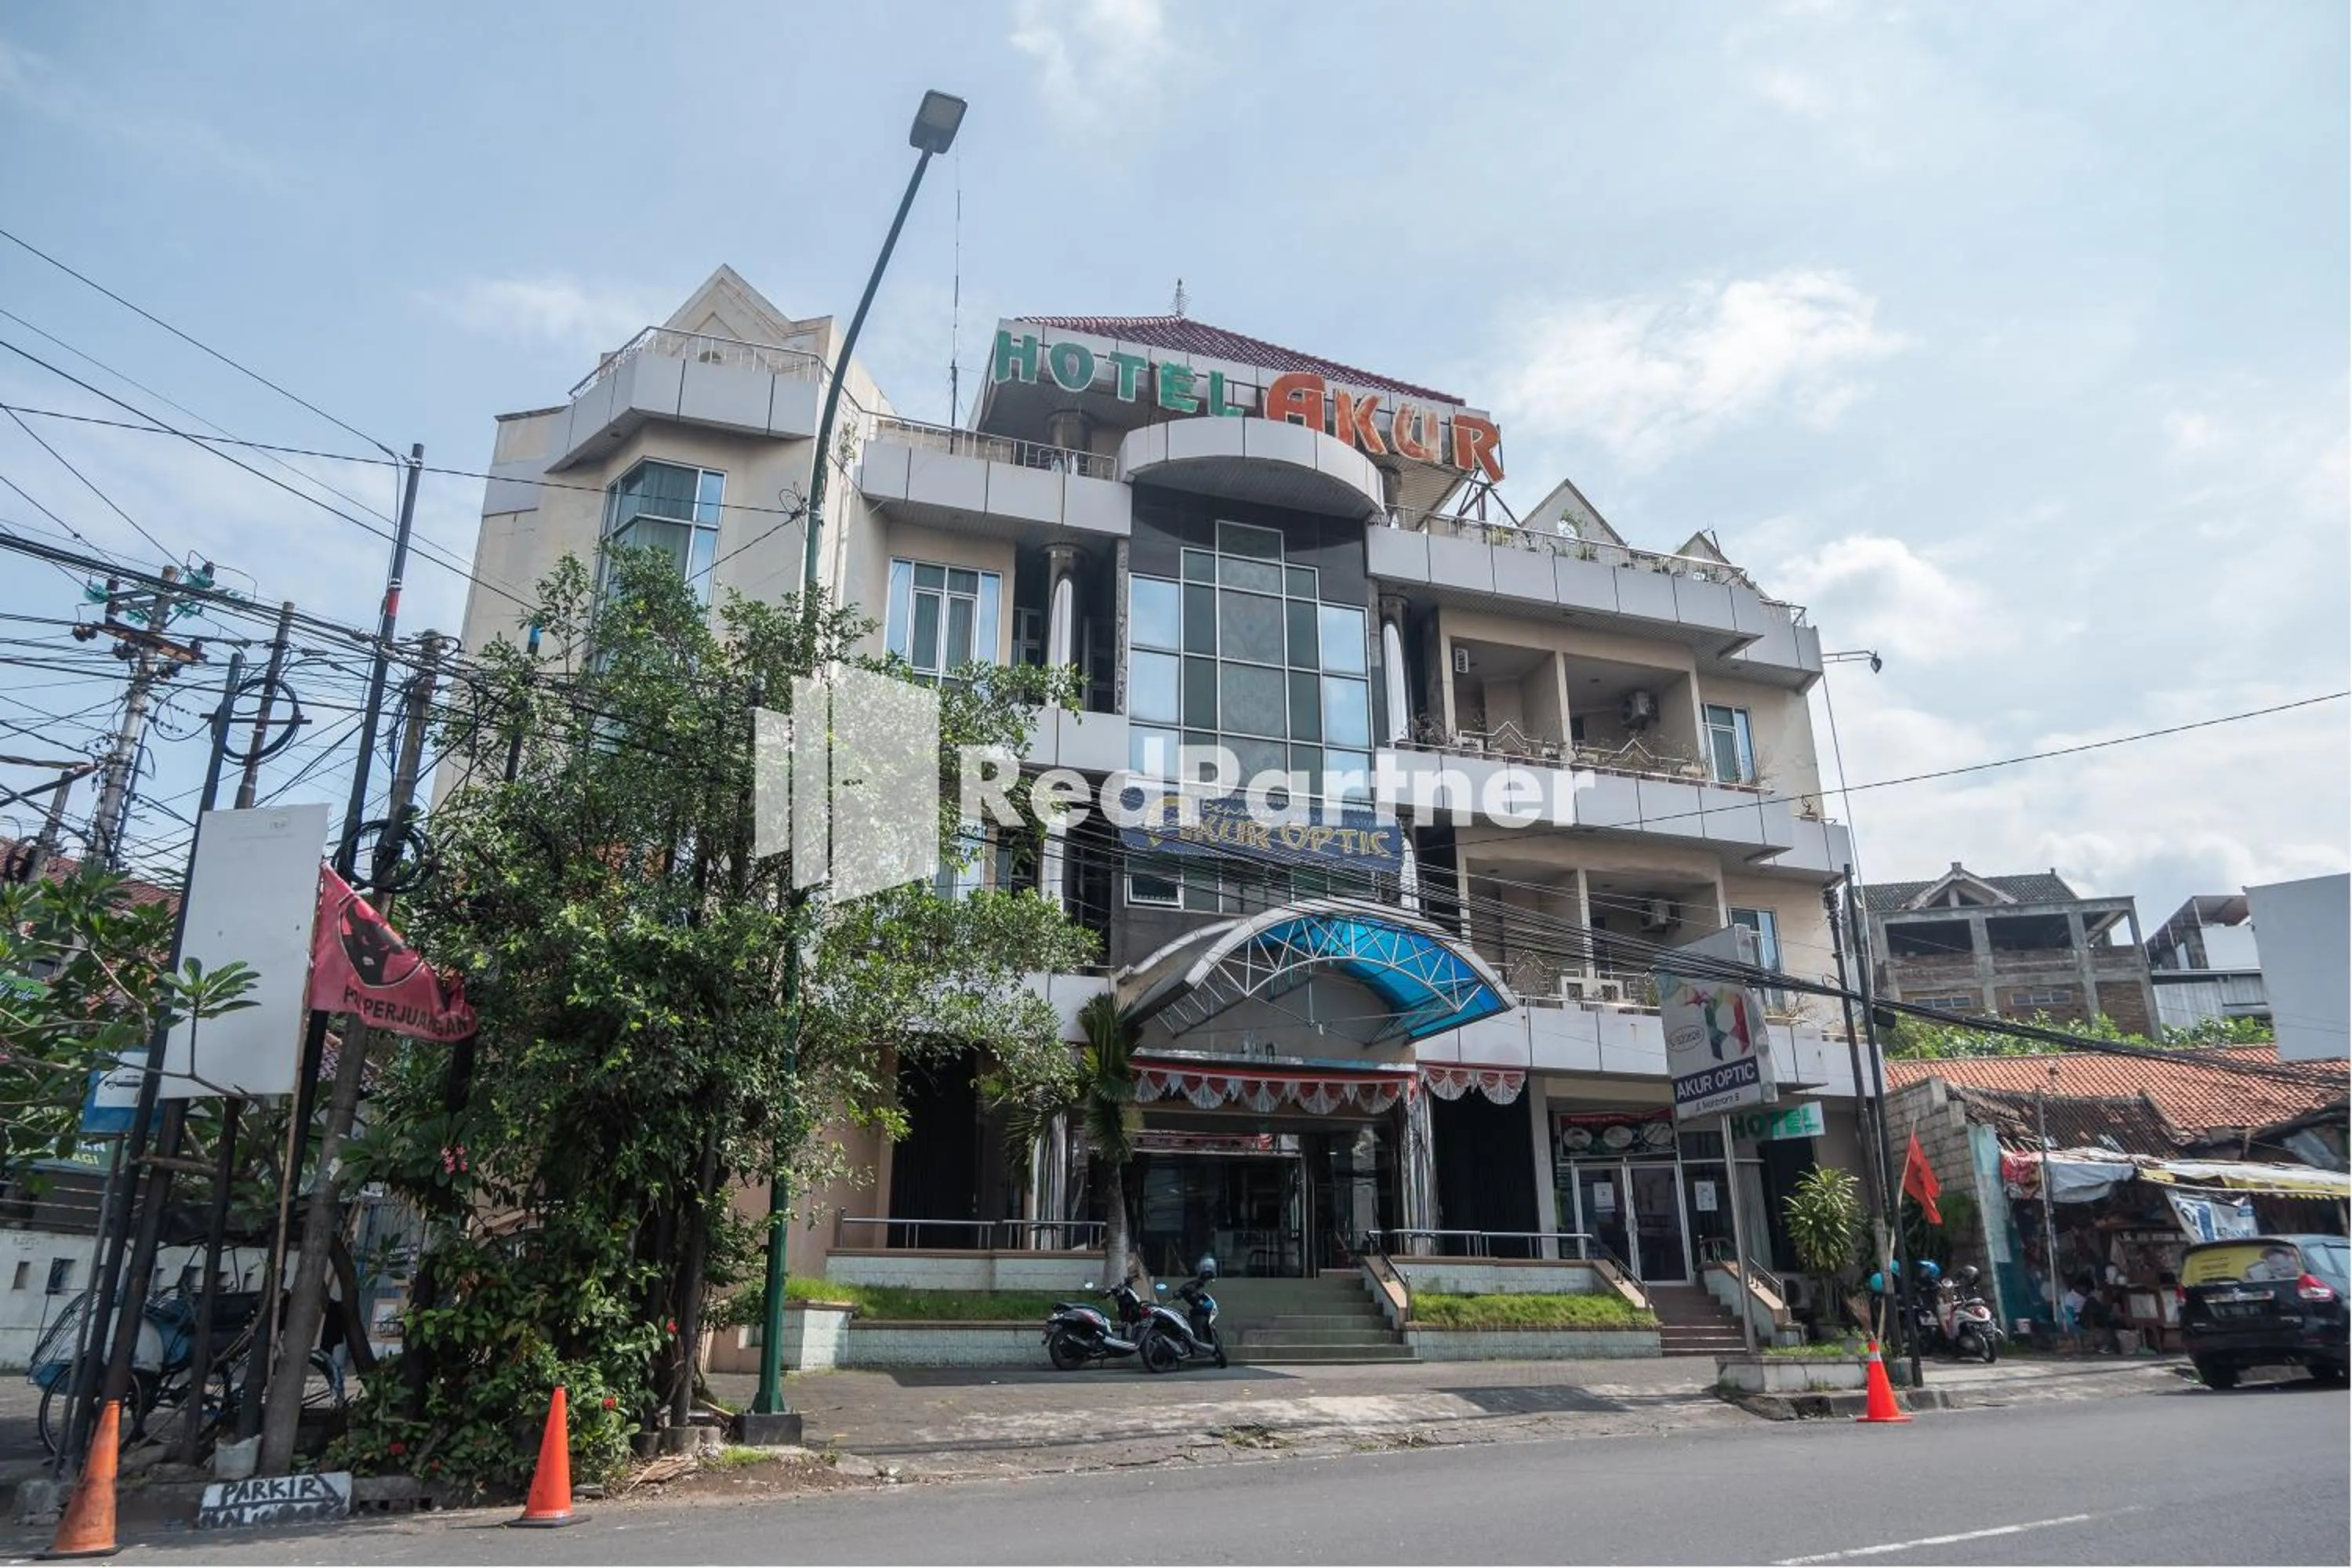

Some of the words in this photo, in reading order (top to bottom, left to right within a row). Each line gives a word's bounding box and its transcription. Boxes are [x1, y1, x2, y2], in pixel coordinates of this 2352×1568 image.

[993, 329, 1246, 418] HOTEL
[1263, 371, 1504, 485] AKUR
[1279, 822, 1392, 858] OPTIC
[1677, 1075, 1713, 1099] AKUR
[1715, 1062, 1755, 1087] OPTIC
[1730, 1106, 1820, 1139] HOTEL
[220, 1475, 320, 1507] PARKIR
